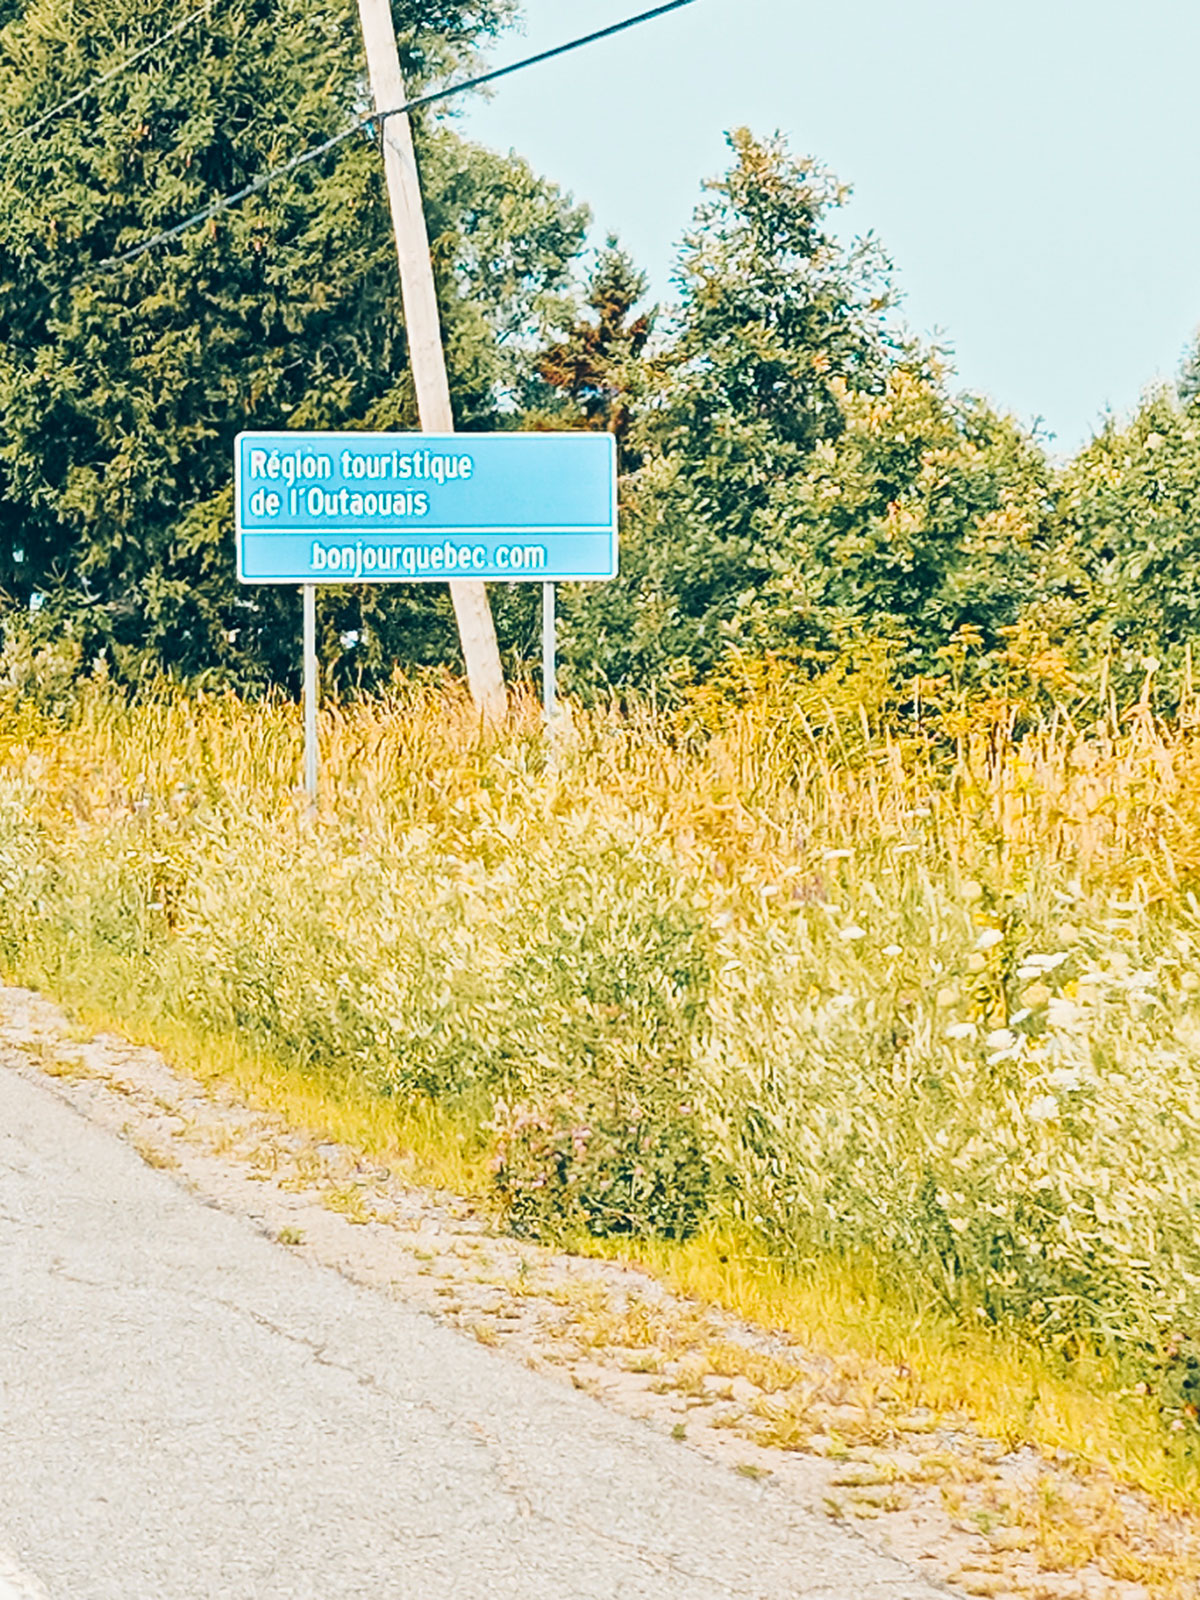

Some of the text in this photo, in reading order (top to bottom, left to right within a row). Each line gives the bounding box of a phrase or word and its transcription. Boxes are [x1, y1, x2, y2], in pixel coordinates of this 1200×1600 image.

[250, 449, 472, 484] Région touristique
[250, 487, 428, 515] de l'Outaouais
[311, 542, 545, 576] bonjourquebec.com
